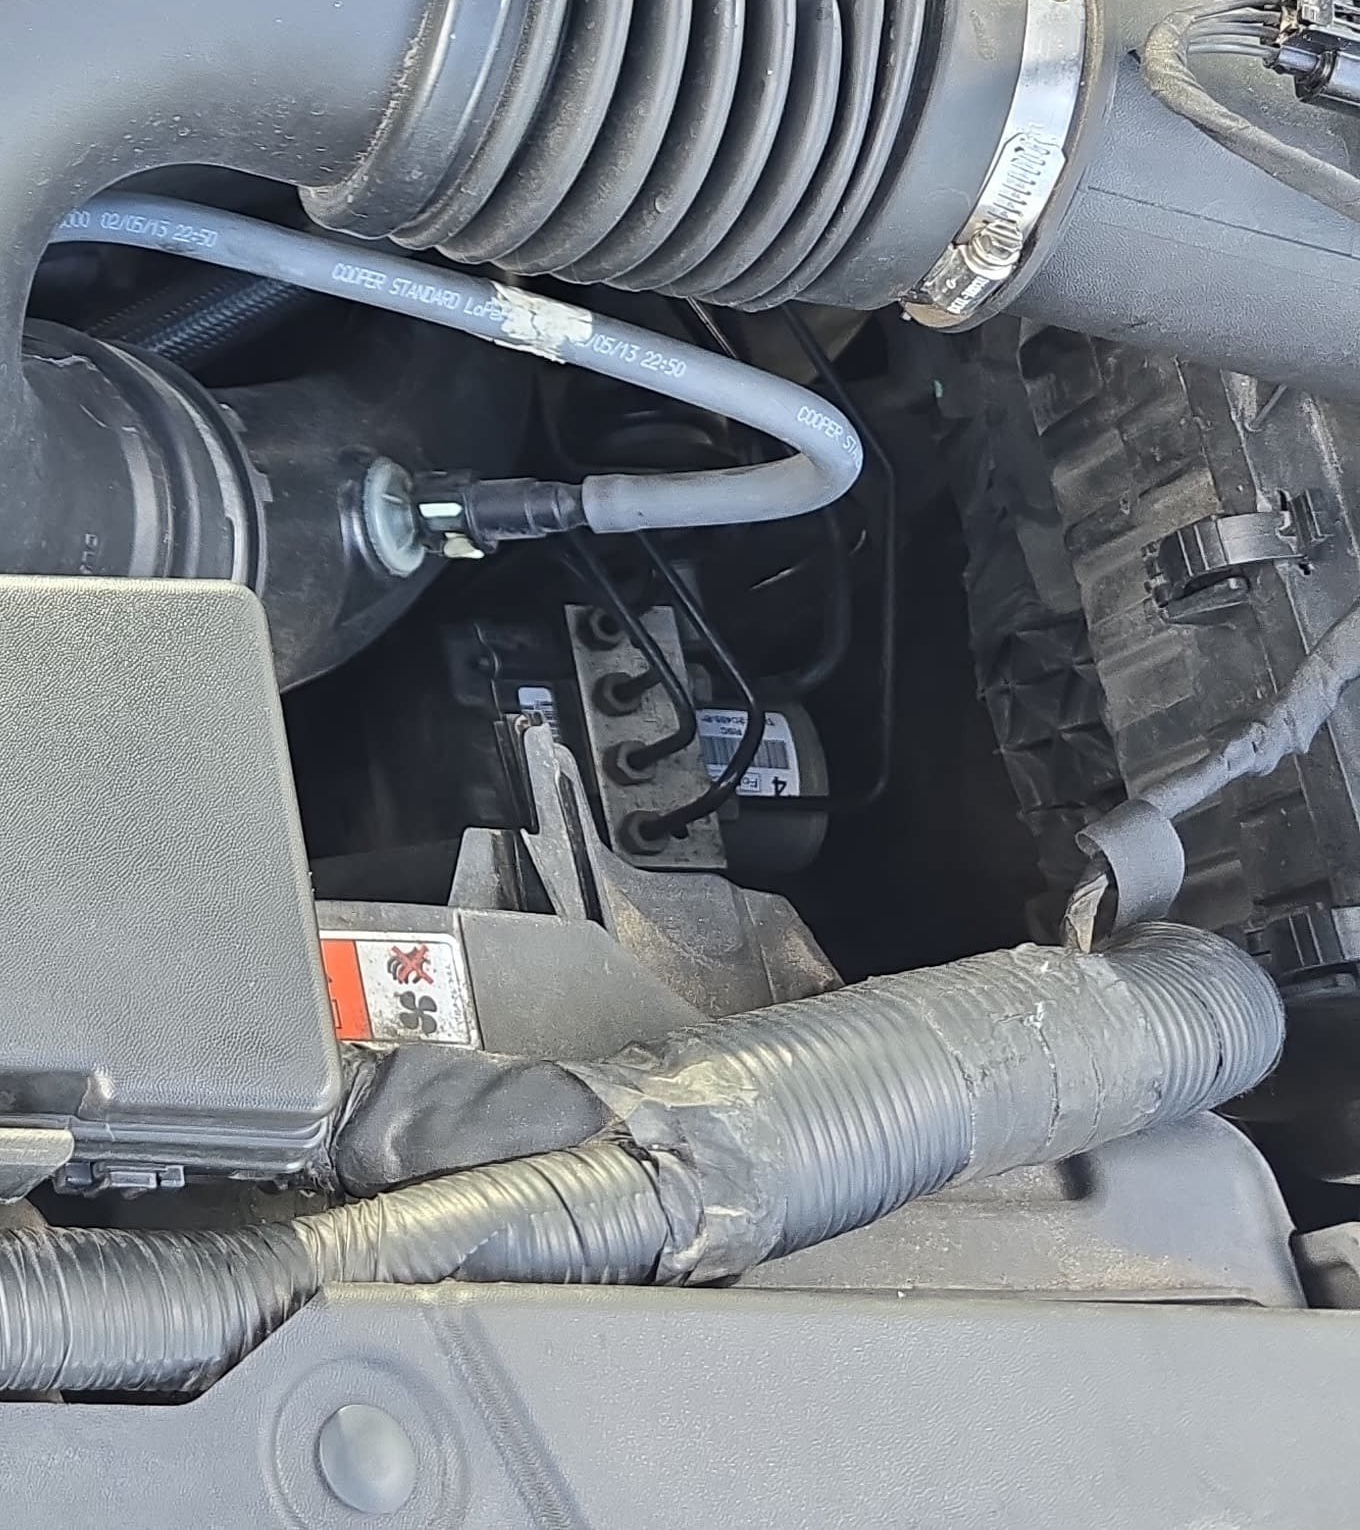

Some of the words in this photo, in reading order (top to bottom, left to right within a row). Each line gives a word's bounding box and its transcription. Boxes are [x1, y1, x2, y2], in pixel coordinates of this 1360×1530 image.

[331, 261, 387, 290] COOPER
[389, 278, 461, 311] STANDARD
[639, 349, 687, 379] 22:50
[796, 404, 843, 442] COOPER
